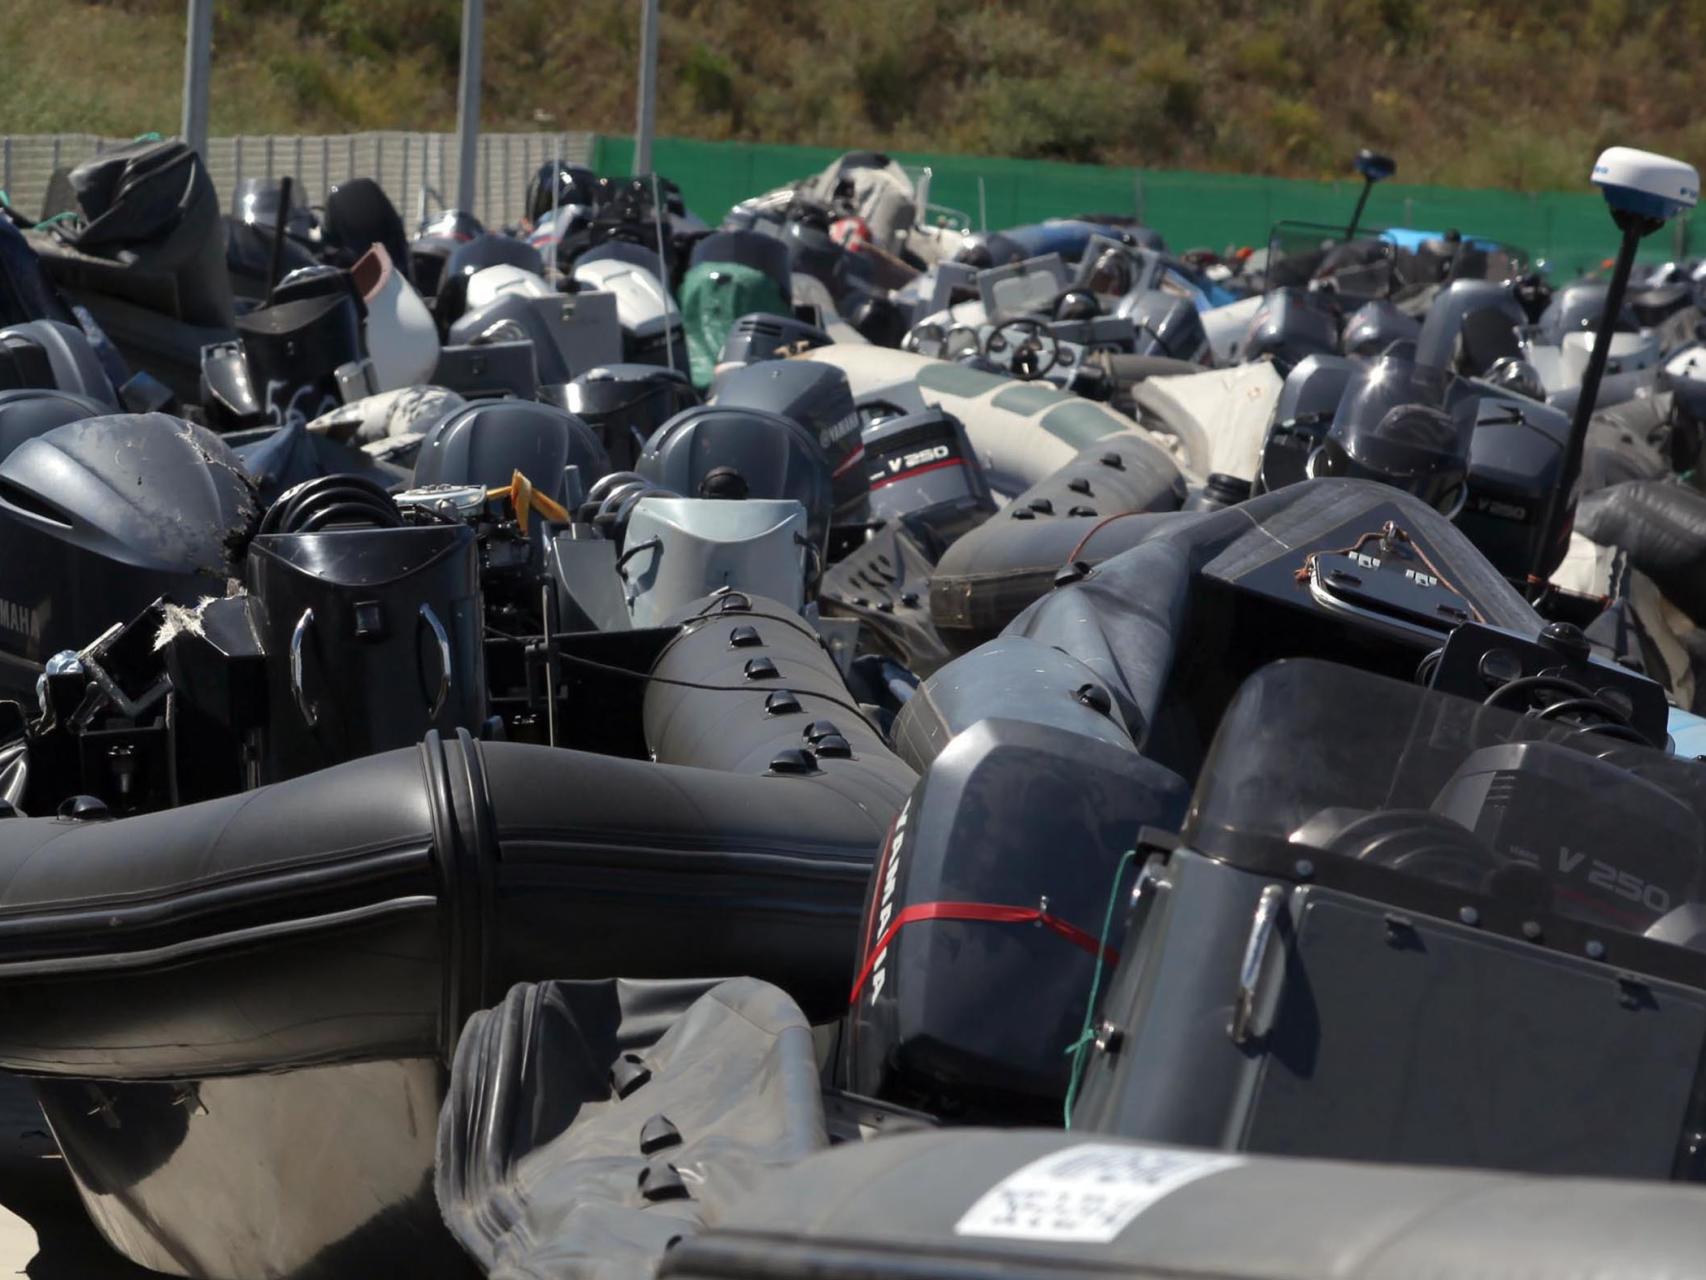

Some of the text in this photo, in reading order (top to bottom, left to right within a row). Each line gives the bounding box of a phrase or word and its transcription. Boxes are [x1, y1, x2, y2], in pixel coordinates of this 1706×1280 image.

[265, 380, 338, 427] 56
[888, 445, 949, 472] V 250
[1558, 846, 1587, 873] V
[1588, 860, 1670, 915] 250
